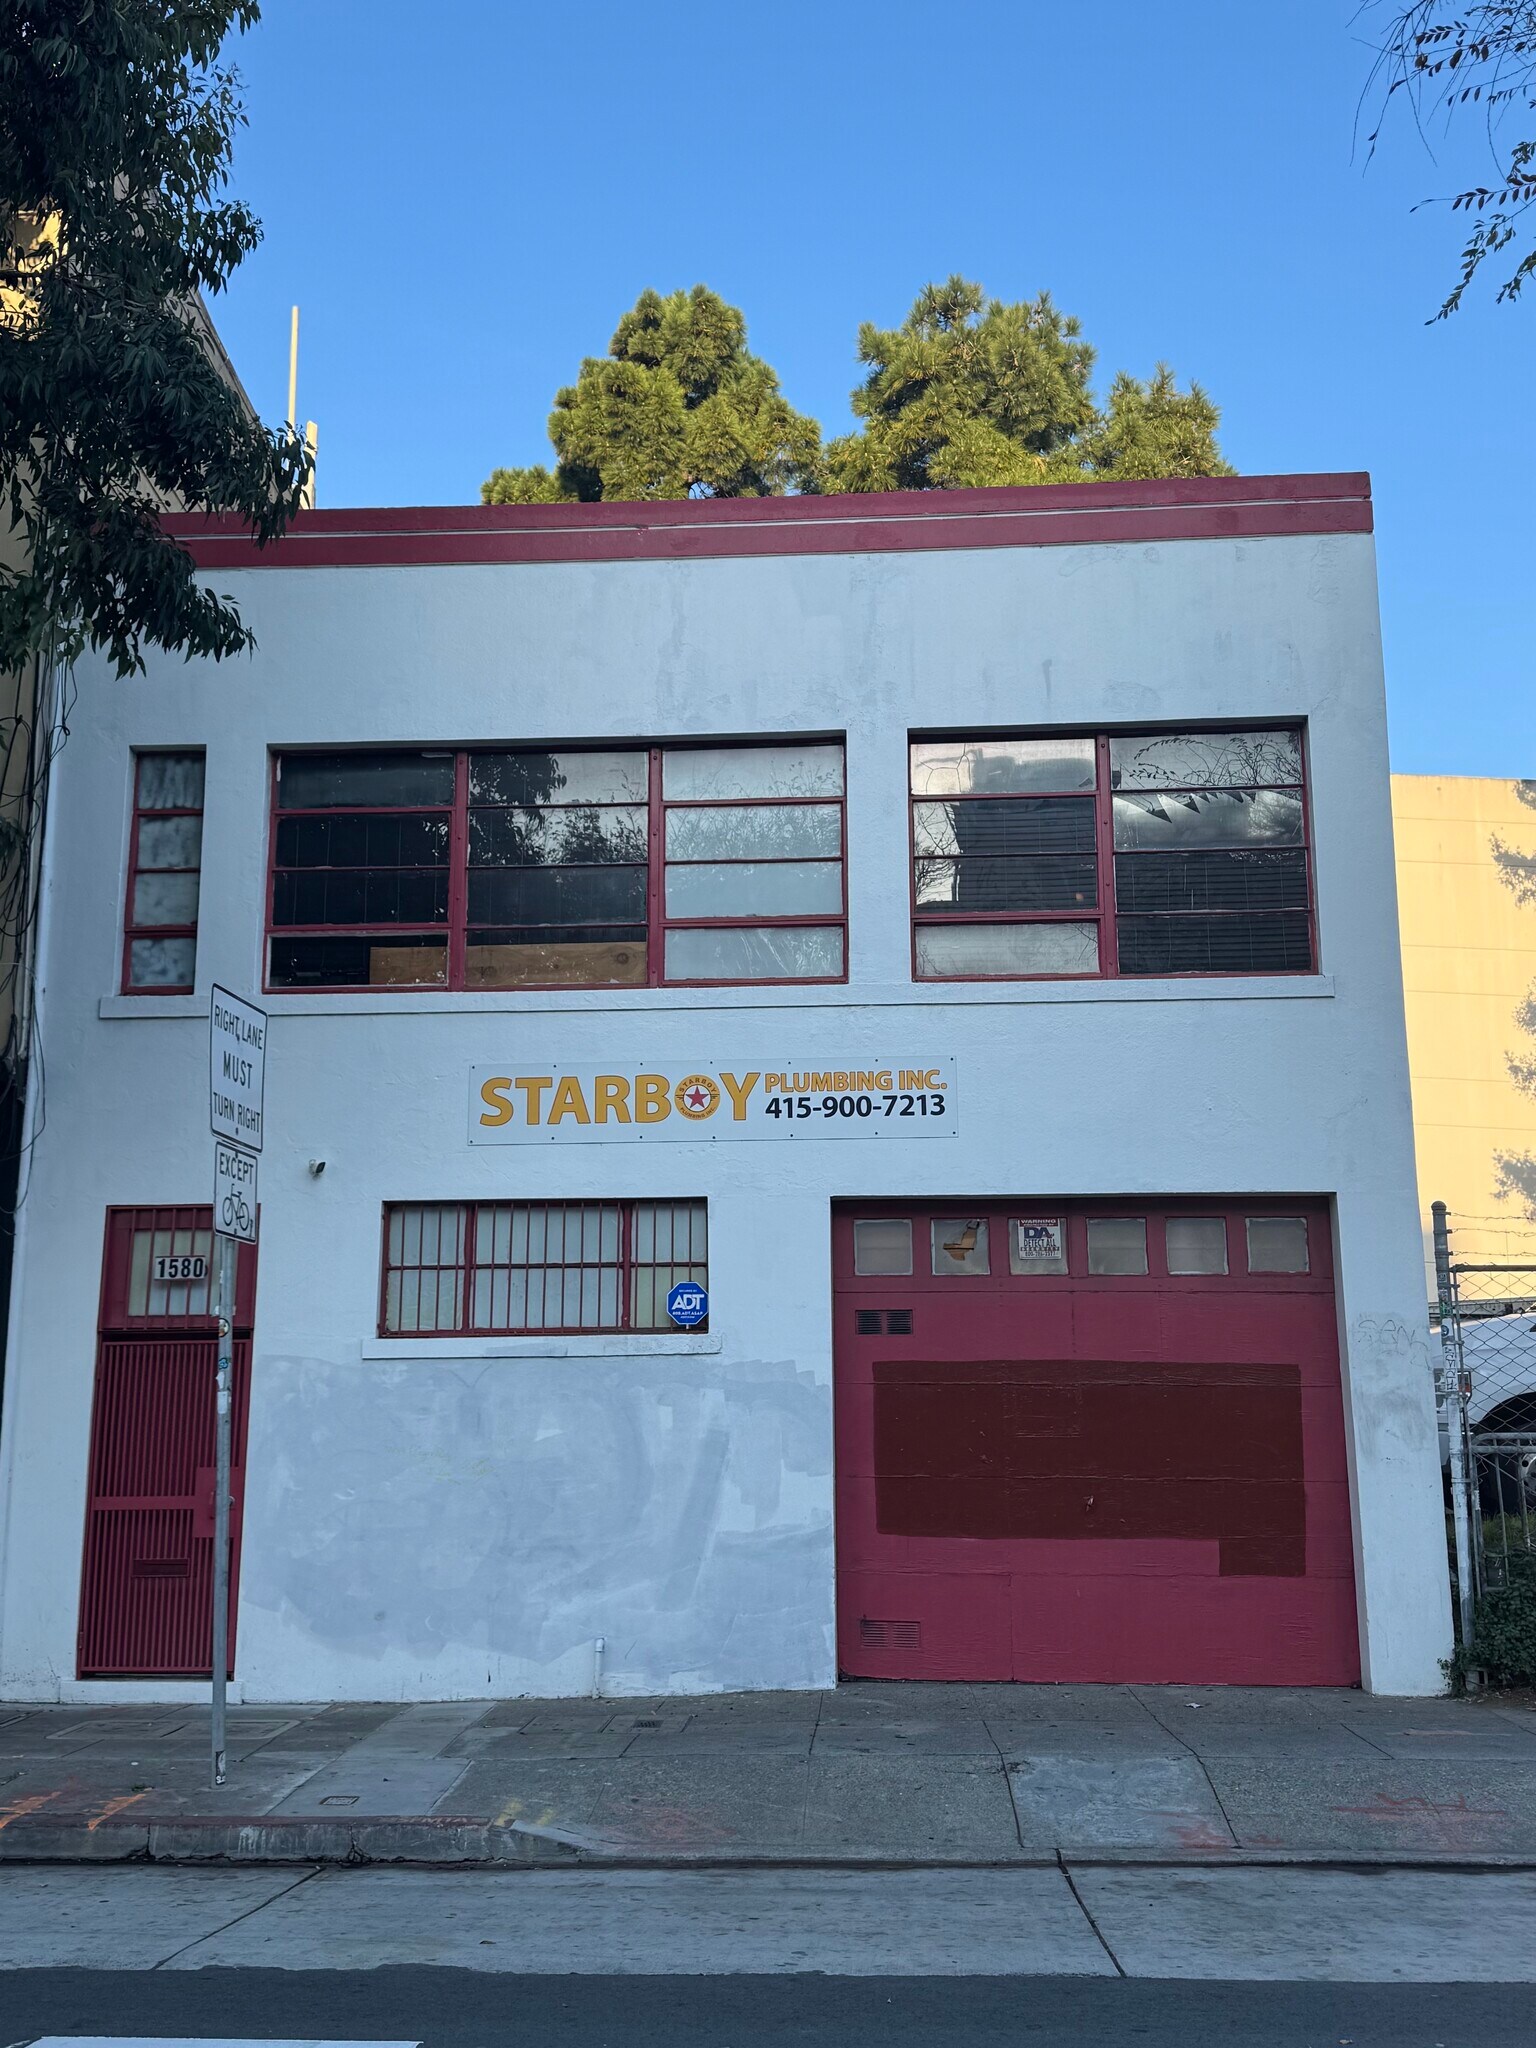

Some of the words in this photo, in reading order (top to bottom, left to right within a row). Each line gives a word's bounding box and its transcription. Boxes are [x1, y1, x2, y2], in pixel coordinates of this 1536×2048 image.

[214, 1004, 240, 1037] RIGHT
[241, 1019, 263, 1050] LANE
[223, 1050, 253, 1089] MUST
[764, 1070, 893, 1093] PLUMBING
[898, 1069, 948, 1090] INC.
[679, 1077, 717, 1093] STARBOY
[479, 1072, 761, 1127] STARBOY
[765, 1094, 946, 1118] 415-900-7213
[213, 1091, 235, 1122] TURN
[237, 1103, 261, 1133] RIGHT
[219, 1152, 254, 1185] EXCEPT
[1024, 1238, 1045, 1247] DETECT
[1046, 1238, 1057, 1247] ALL
[158, 1257, 204, 1278] 1580
[671, 1294, 704, 1310] ADT
